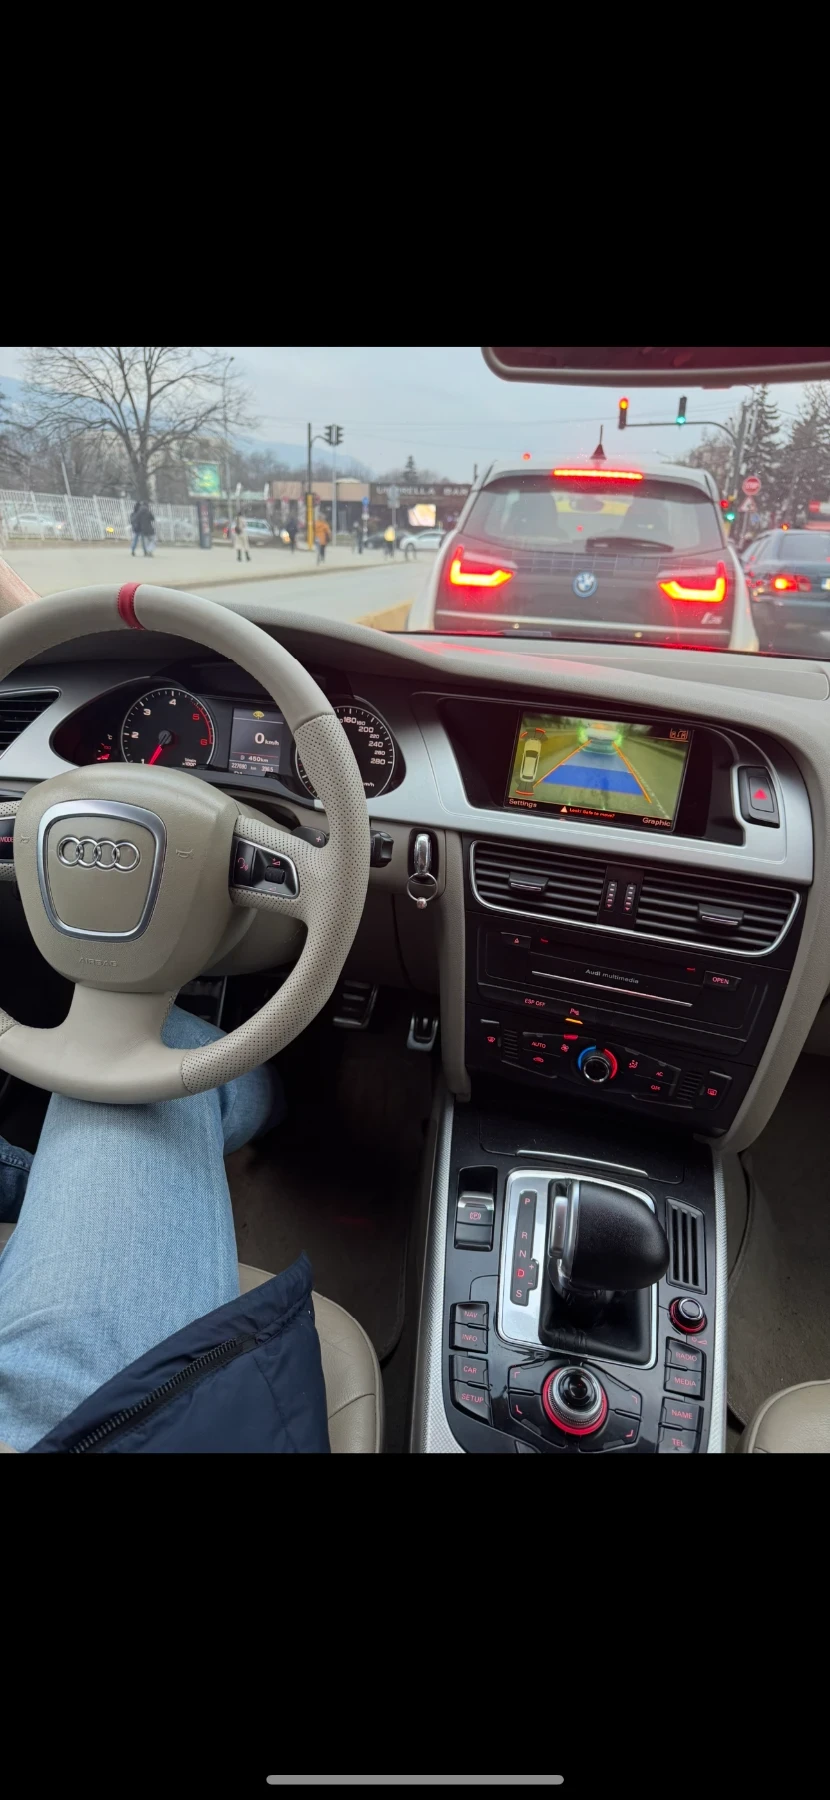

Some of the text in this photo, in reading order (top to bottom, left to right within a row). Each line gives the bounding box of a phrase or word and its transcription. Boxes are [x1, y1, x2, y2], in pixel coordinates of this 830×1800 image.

[143, 708, 151, 716] 3
[192, 713, 200, 721] 5
[131, 731, 139, 739] 2
[254, 732, 265, 744] 0
[200, 738, 208, 746] 6
[508, 798, 538, 808] Settings
[642, 816, 671, 827] Graphic
[79, 957, 118, 967] AIRBAG
[602, 973, 639, 984] multimedia
[712, 976, 730, 985] OPEN
[531, 1041, 547, 1049] AUTO
[524, 1197, 531, 1205] P
[521, 1231, 528, 1239] R
[519, 1249, 527, 1258] N
[517, 1269, 525, 1277] D
[515, 1289, 523, 1298] S
[464, 1310, 478, 1319] NAV
[461, 1333, 478, 1342] INFO
[675, 1351, 698, 1362] RADIO
[463, 1365, 478, 1374] CAR
[674, 1376, 697, 1387] MEDIA
[461, 1393, 484, 1403] SETUP
[671, 1409, 693, 1420] NAME
[671, 1438, 686, 1448] TEL
